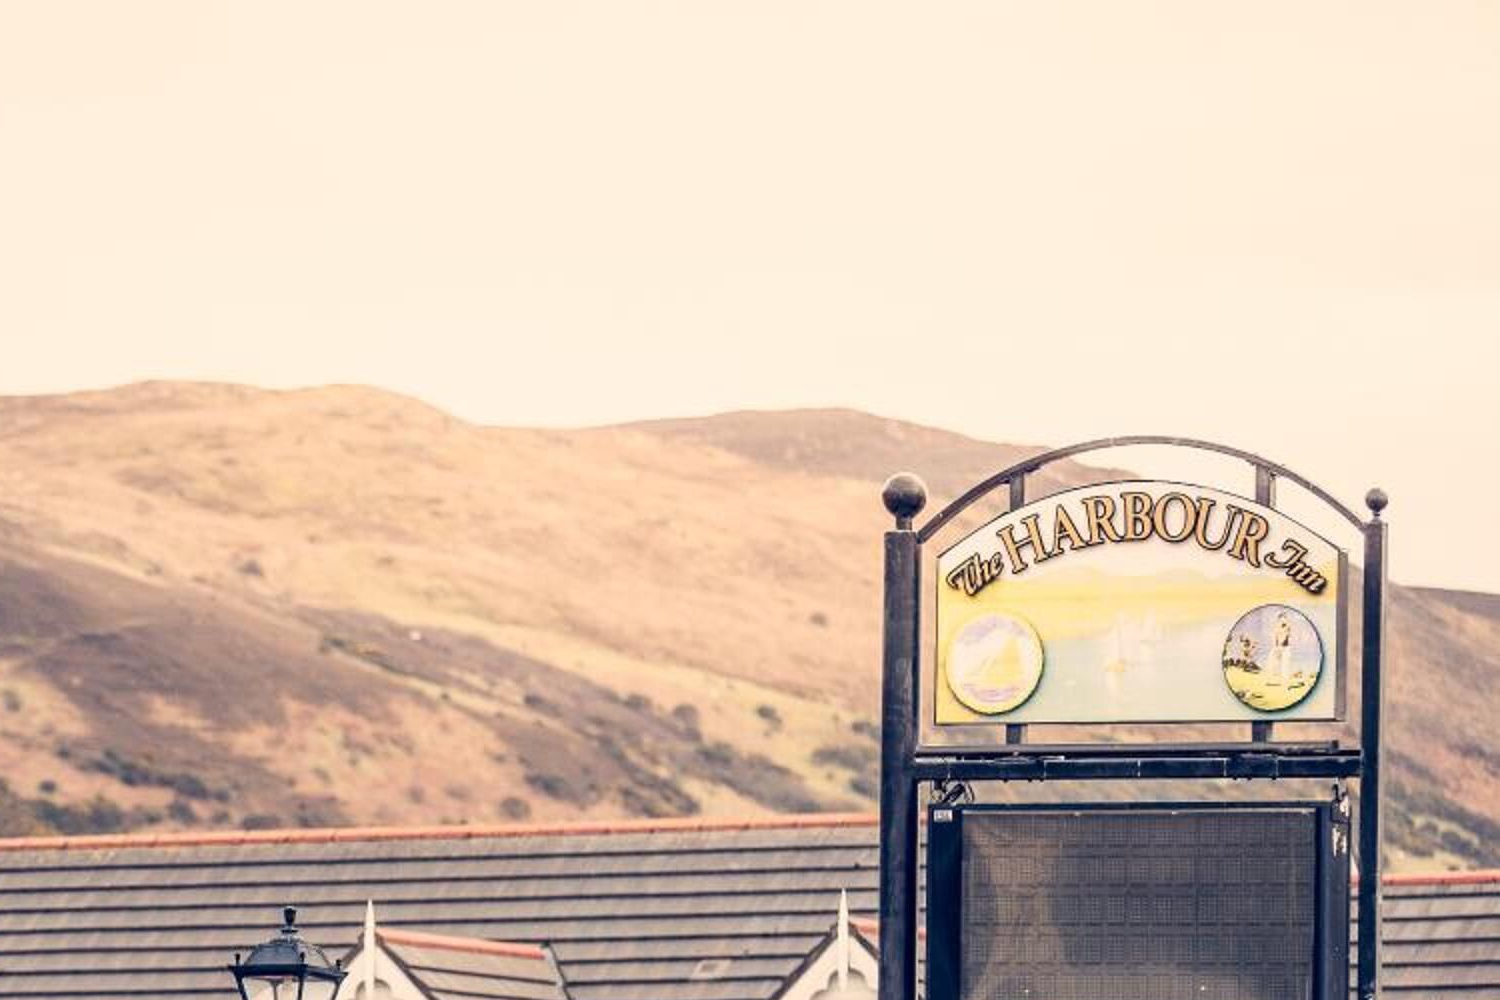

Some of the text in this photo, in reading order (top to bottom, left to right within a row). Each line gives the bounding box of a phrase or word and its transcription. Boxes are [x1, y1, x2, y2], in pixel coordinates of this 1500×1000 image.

[946, 491, 1327, 596] The HARBOUR Inn
